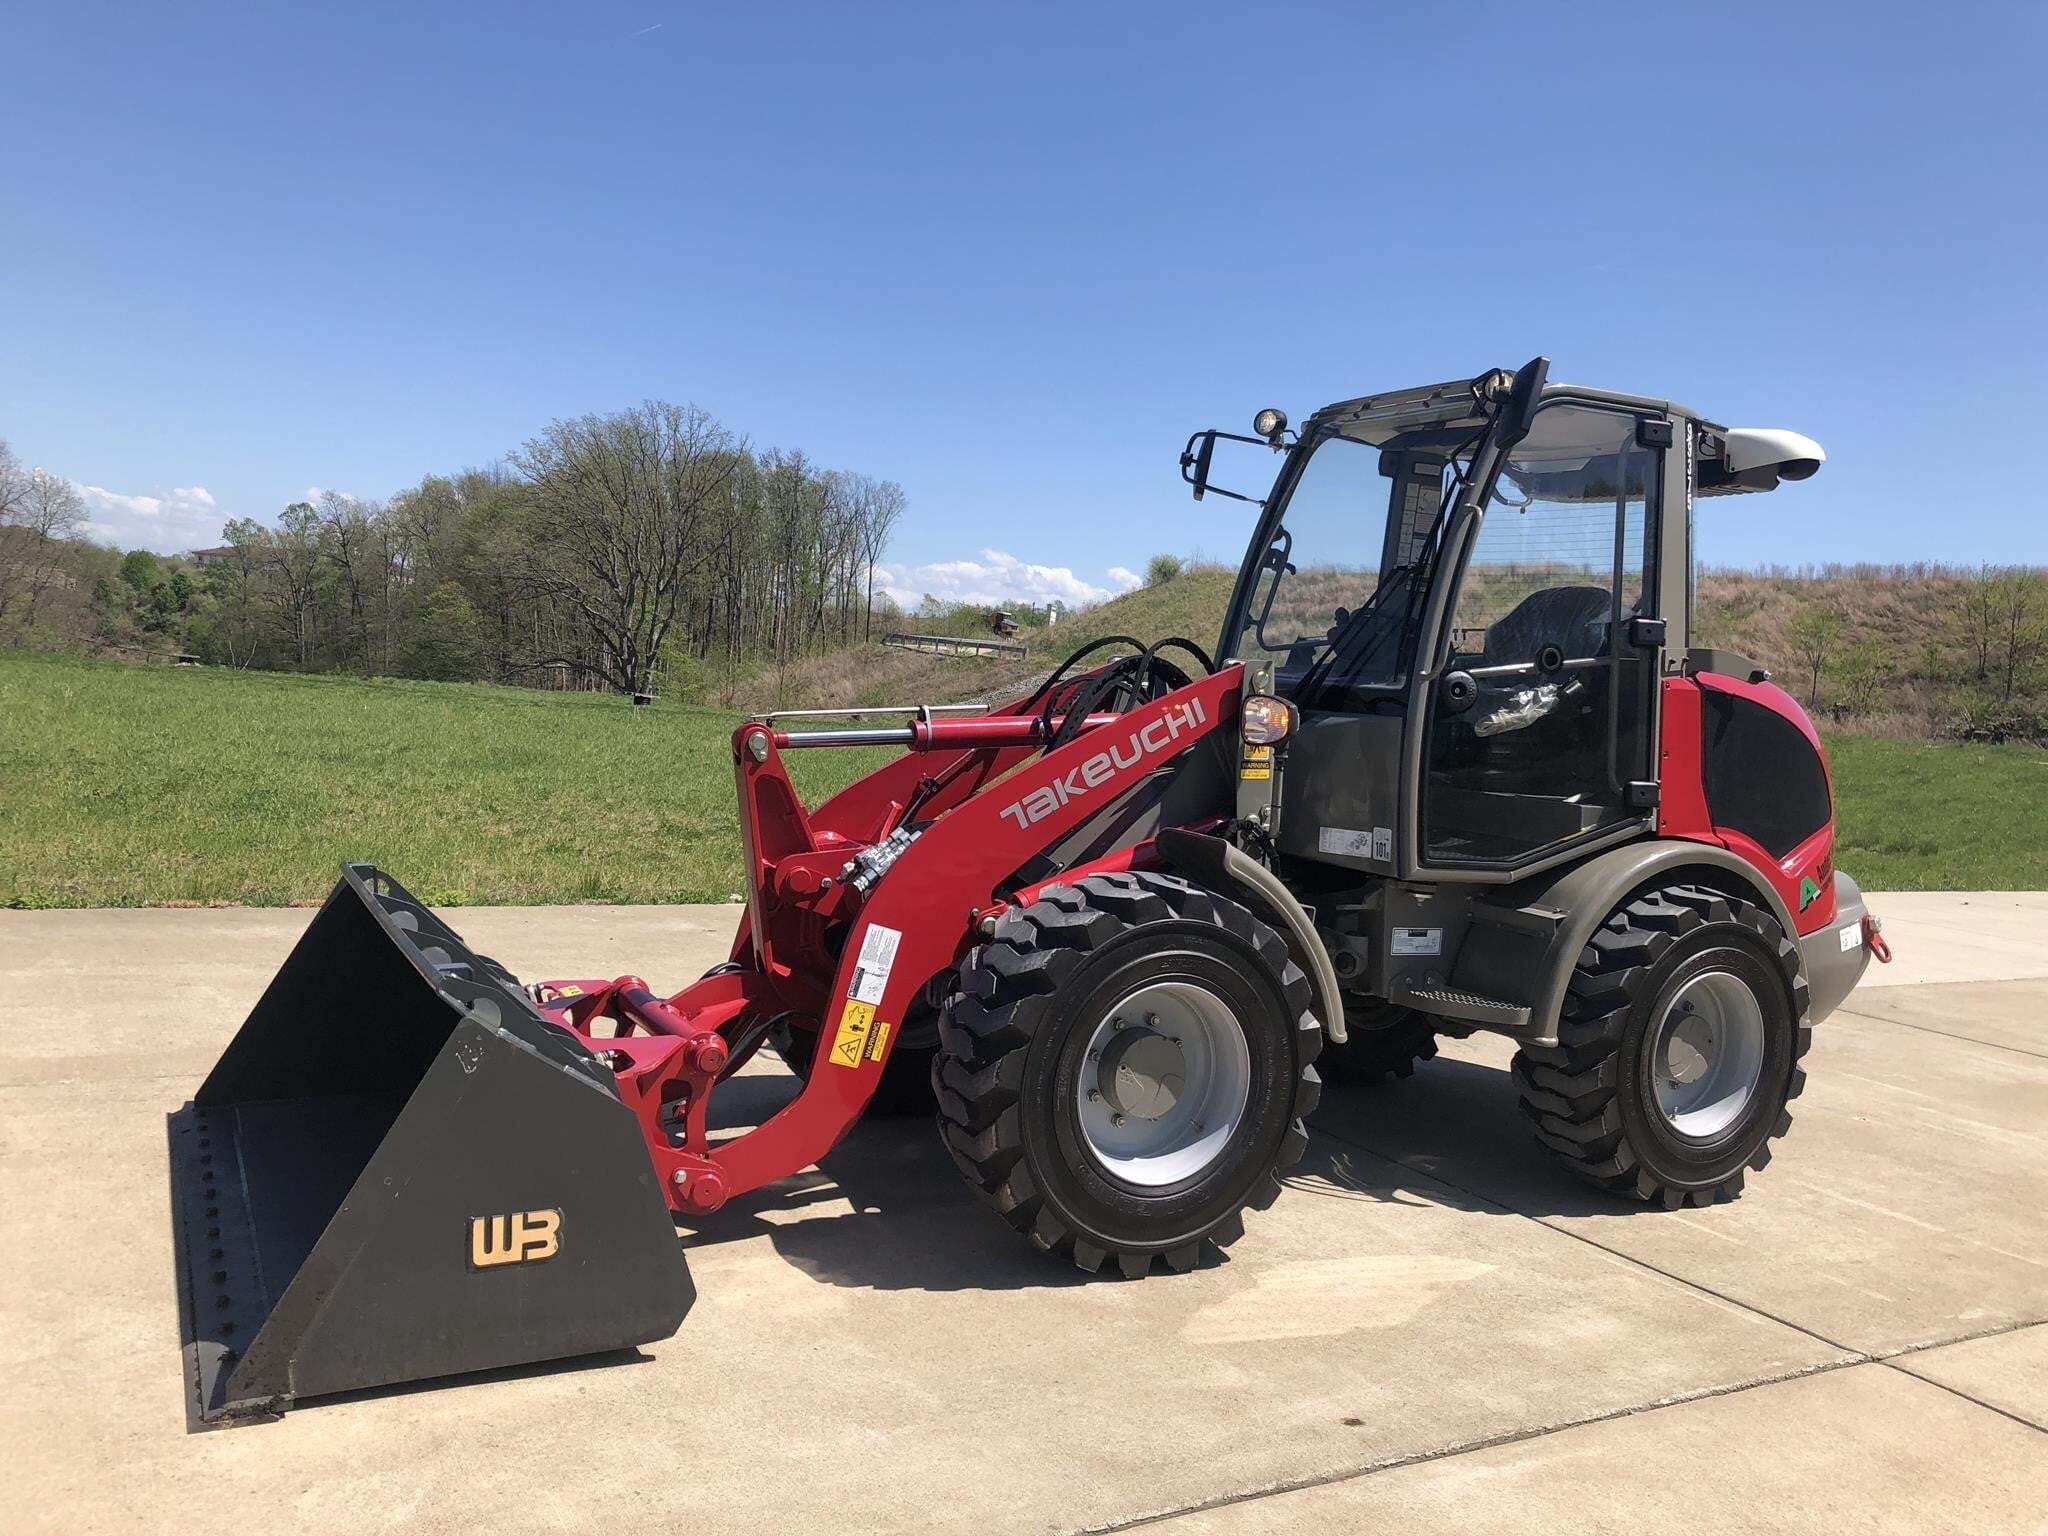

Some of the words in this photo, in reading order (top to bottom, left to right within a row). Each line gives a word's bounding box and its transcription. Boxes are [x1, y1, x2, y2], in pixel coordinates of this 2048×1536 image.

[1000, 697, 1206, 830] TAKEUCHI
[864, 1021, 882, 1059] WARNING
[472, 1209, 561, 1266] WB
